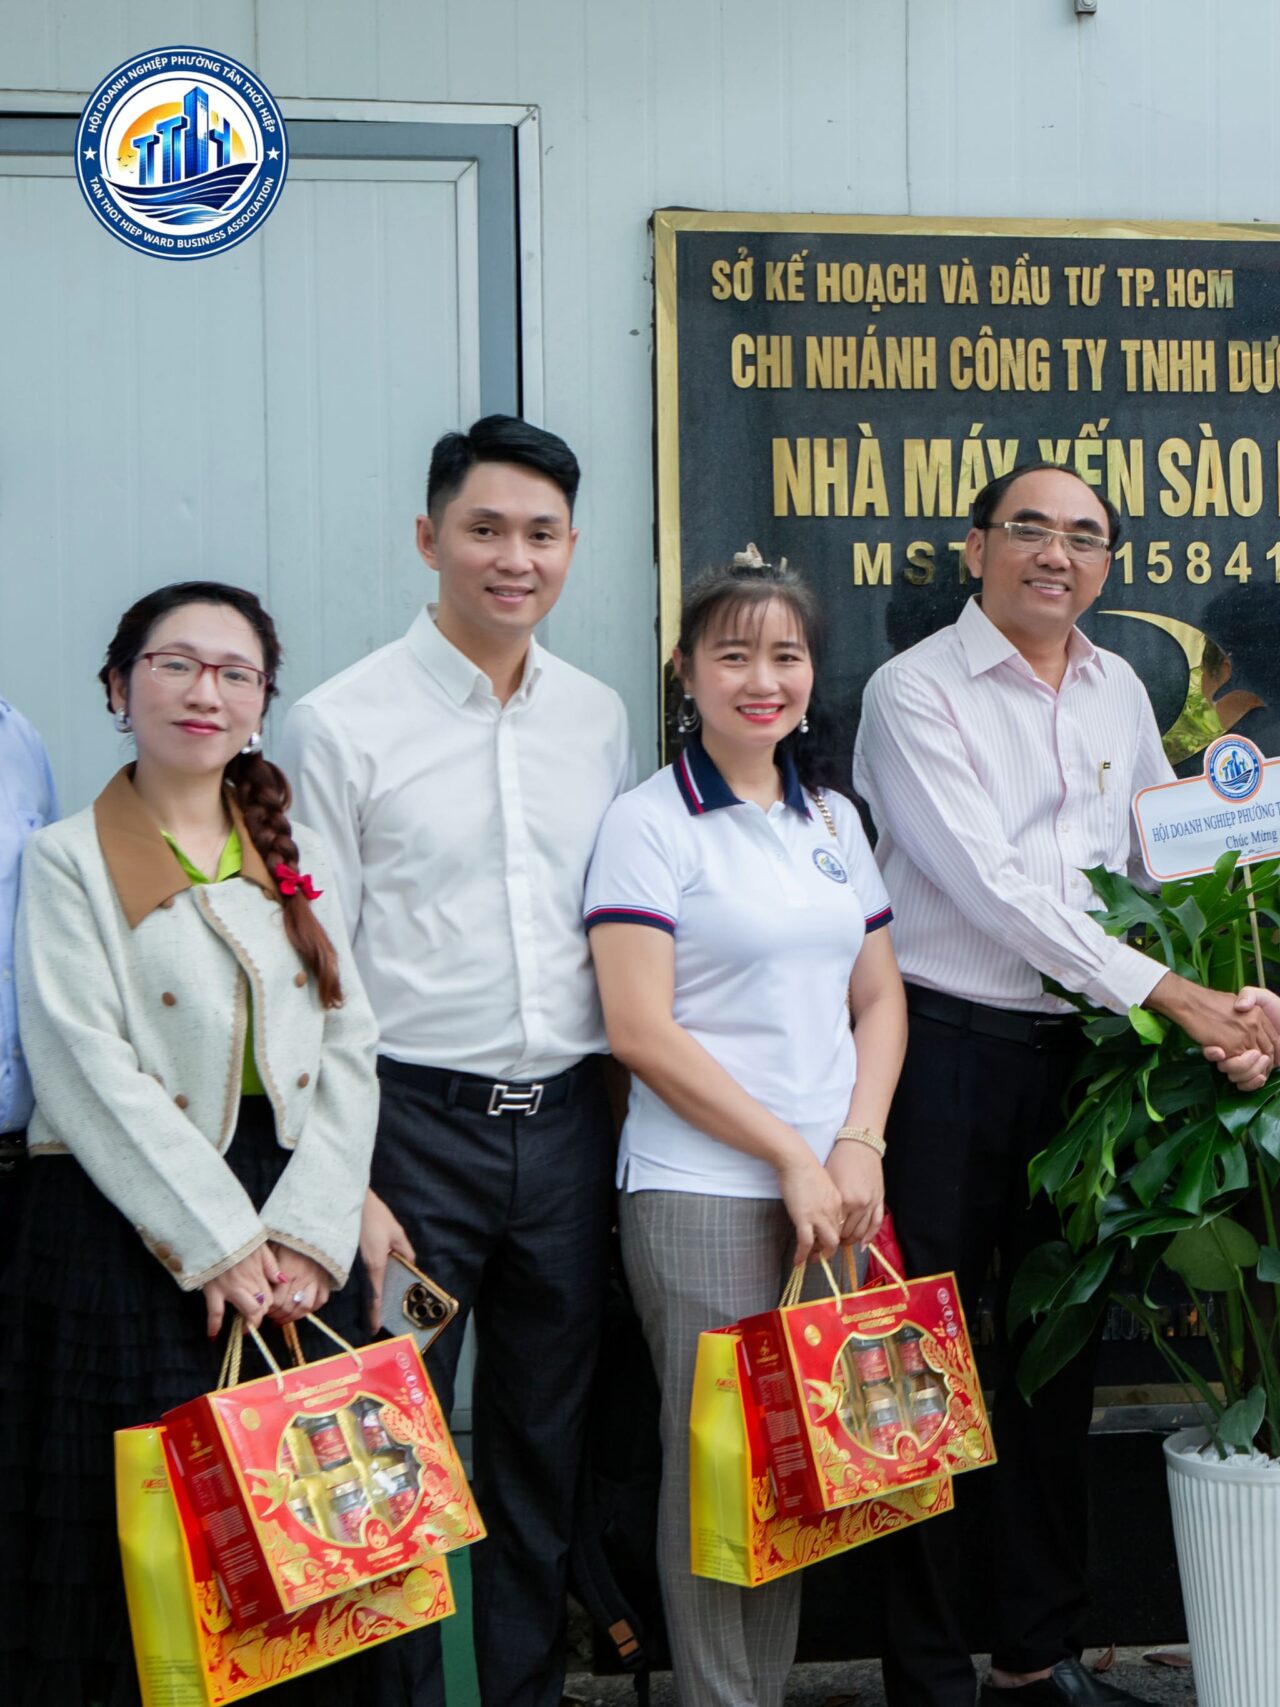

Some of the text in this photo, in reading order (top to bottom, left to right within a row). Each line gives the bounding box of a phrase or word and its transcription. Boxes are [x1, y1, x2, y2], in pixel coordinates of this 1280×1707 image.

[711, 246, 1234, 312] SỞ KẾ HOẠCH VÀ ĐẦU TƯ TP.HCM
[731, 333, 793, 390] CHI
[806, 325, 936, 390] NHÁNH
[950, 325, 1050, 392] CÔNG
[1062, 338, 1107, 392] TY
[1120, 339, 1217, 393] TNHH
[772, 422, 890, 518] NHÀ
[903, 422, 1019, 518] MÁY
[1157, 423, 1263, 518] SÀO
[1152, 823, 1170, 843] HỘI
[1170, 818, 1202, 839] DOANH
[1203, 810, 1237, 831] NGHIỆP
[1238, 803, 1275, 824] PHƯỜNG
[1225, 829, 1278, 850] Chúc Mừng
